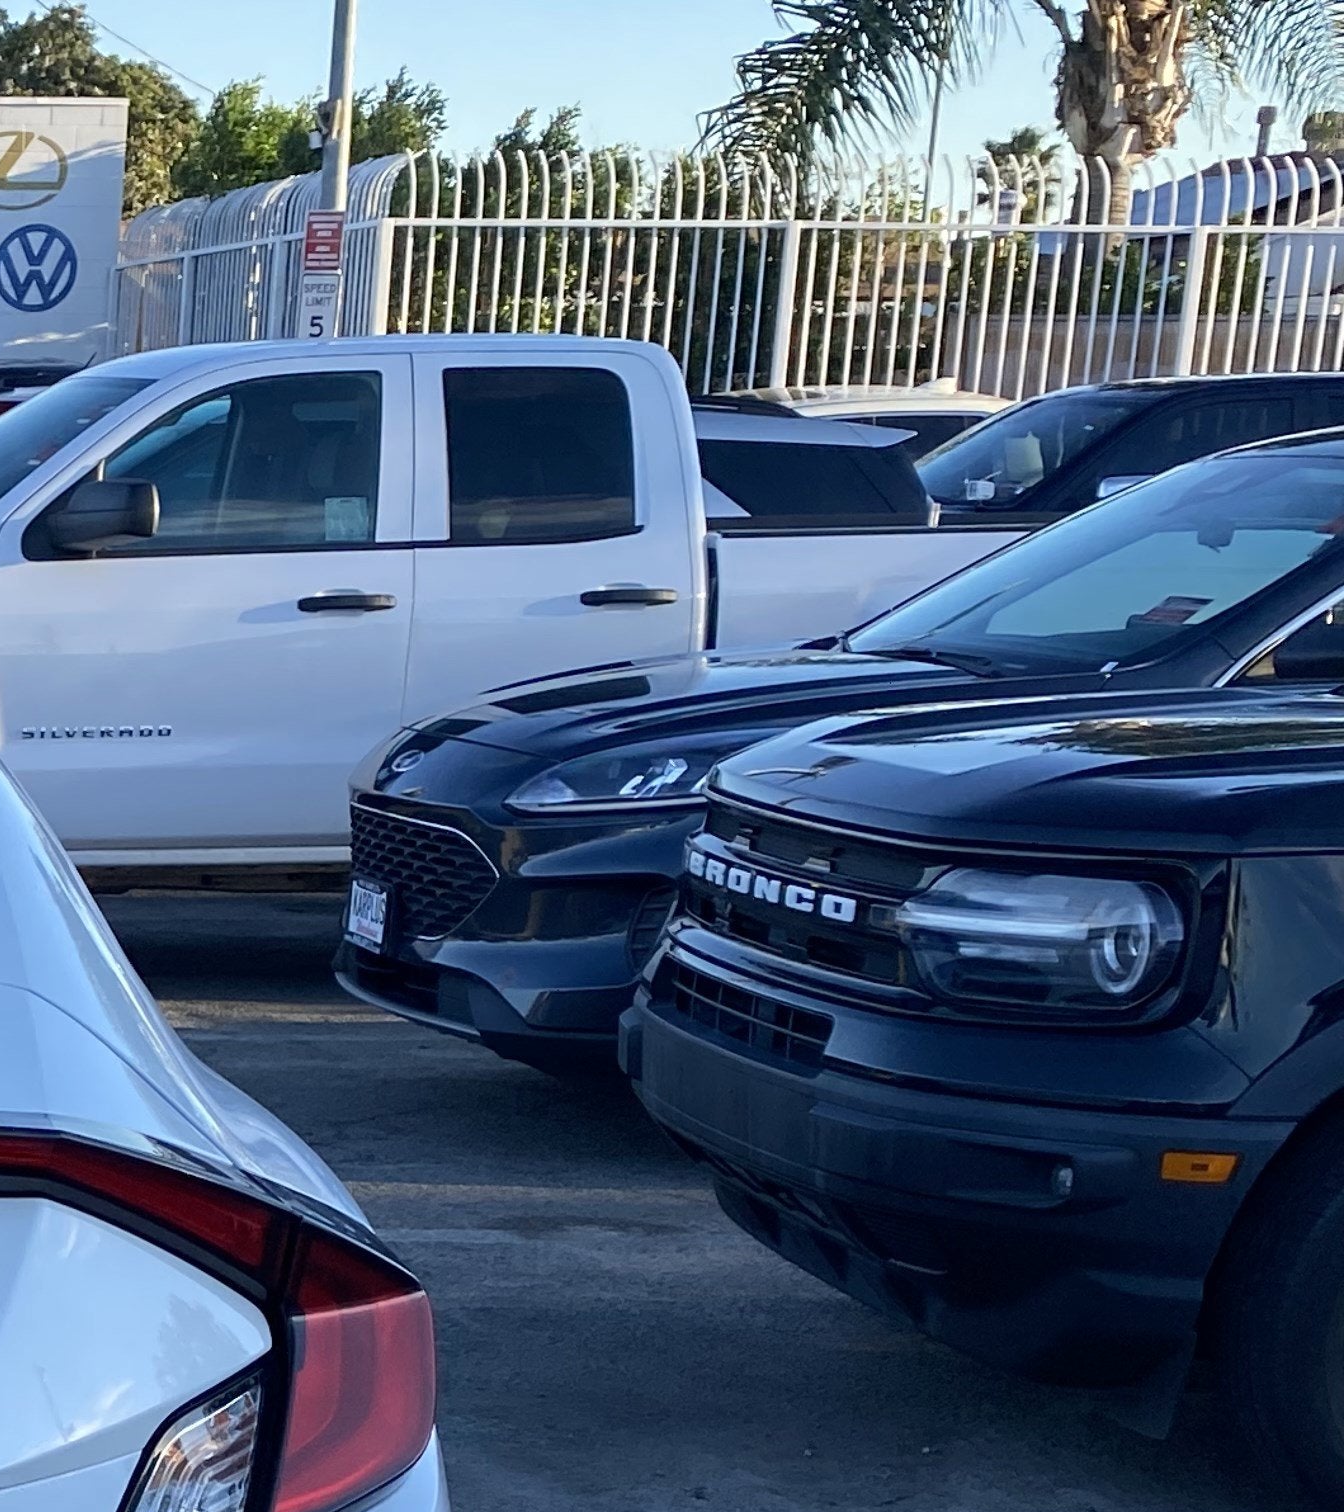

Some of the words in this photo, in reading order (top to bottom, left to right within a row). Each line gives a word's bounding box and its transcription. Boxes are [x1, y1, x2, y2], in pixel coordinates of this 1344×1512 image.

[304, 283, 337, 294] SPEED
[305, 296, 333, 307] LIMIT
[309, 315, 324, 338] 5
[22, 725, 173, 740] SILVERADO
[689, 850, 857, 923] BRONCO
